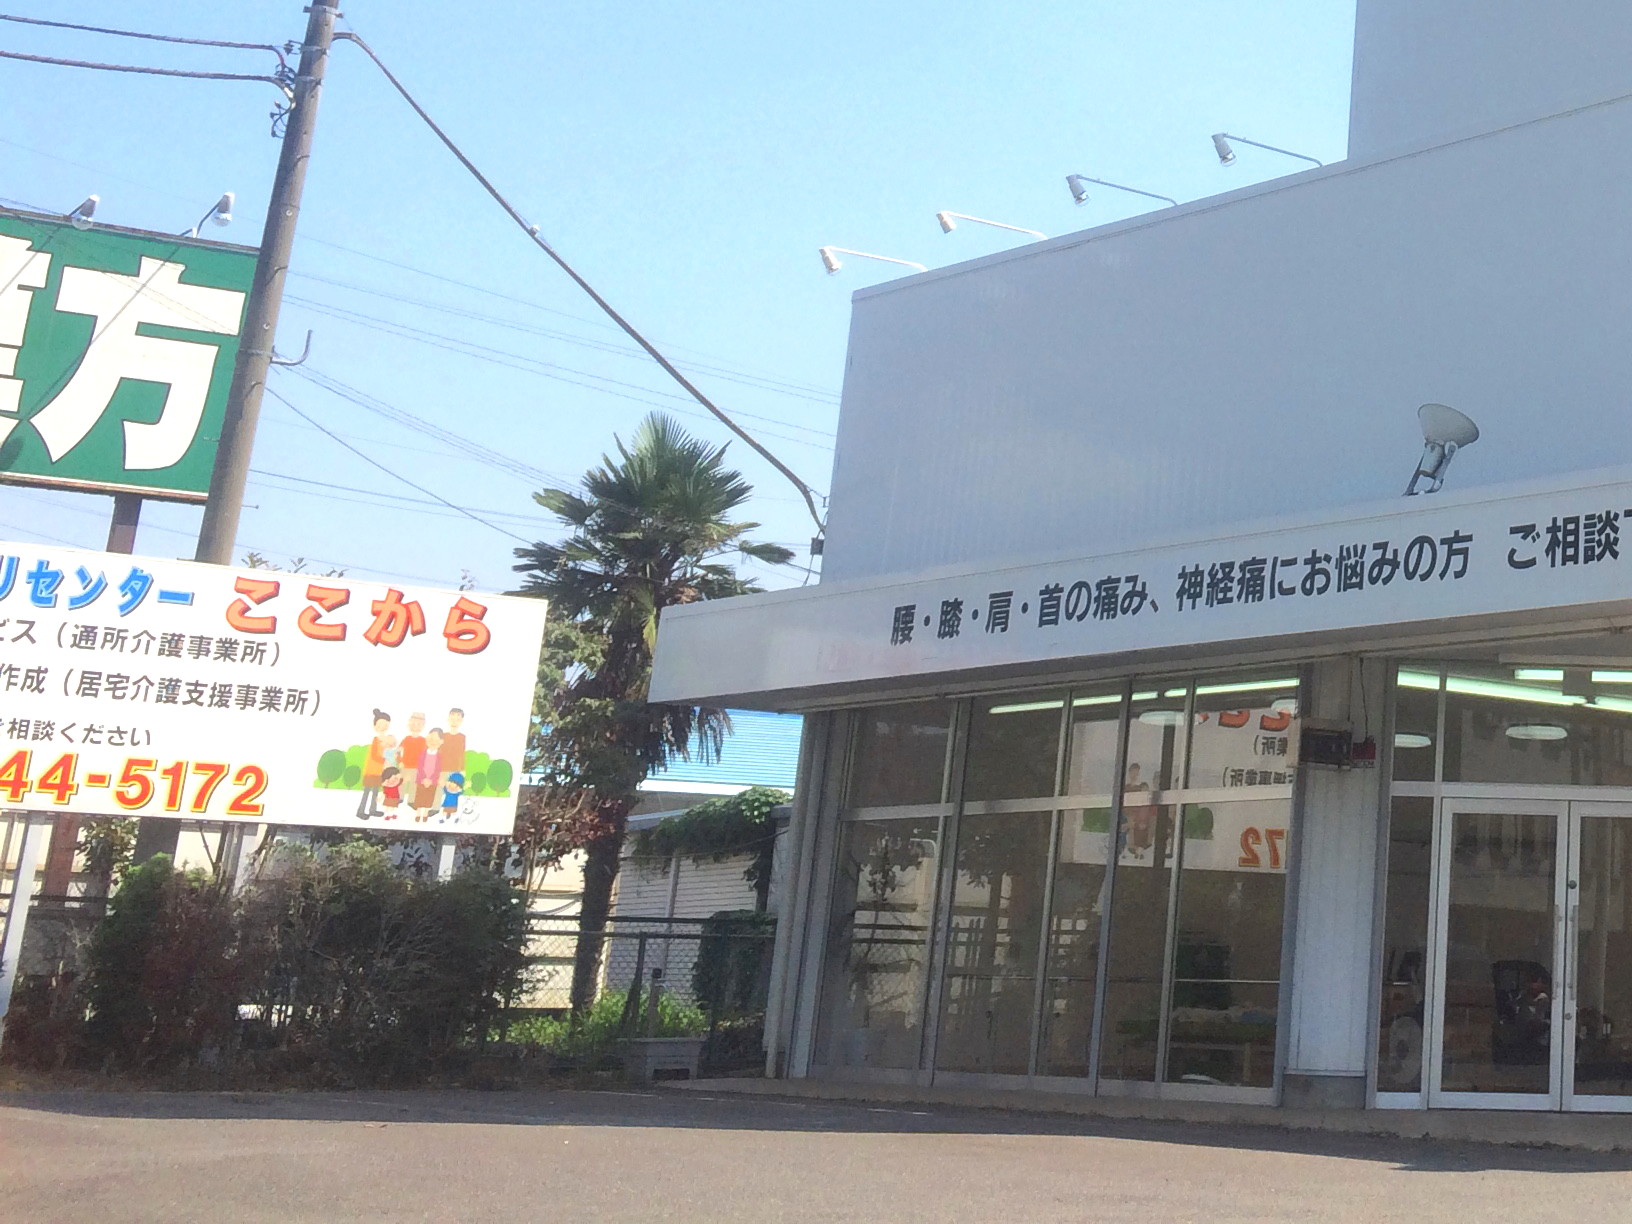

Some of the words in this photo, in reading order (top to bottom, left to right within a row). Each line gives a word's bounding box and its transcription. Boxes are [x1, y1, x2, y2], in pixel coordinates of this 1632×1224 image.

[0, 233, 248, 472] 方
[225, 576, 492, 655] ここから
[0, 717, 151, 746] 相談ください
[0, 749, 269, 817] 44-5172
